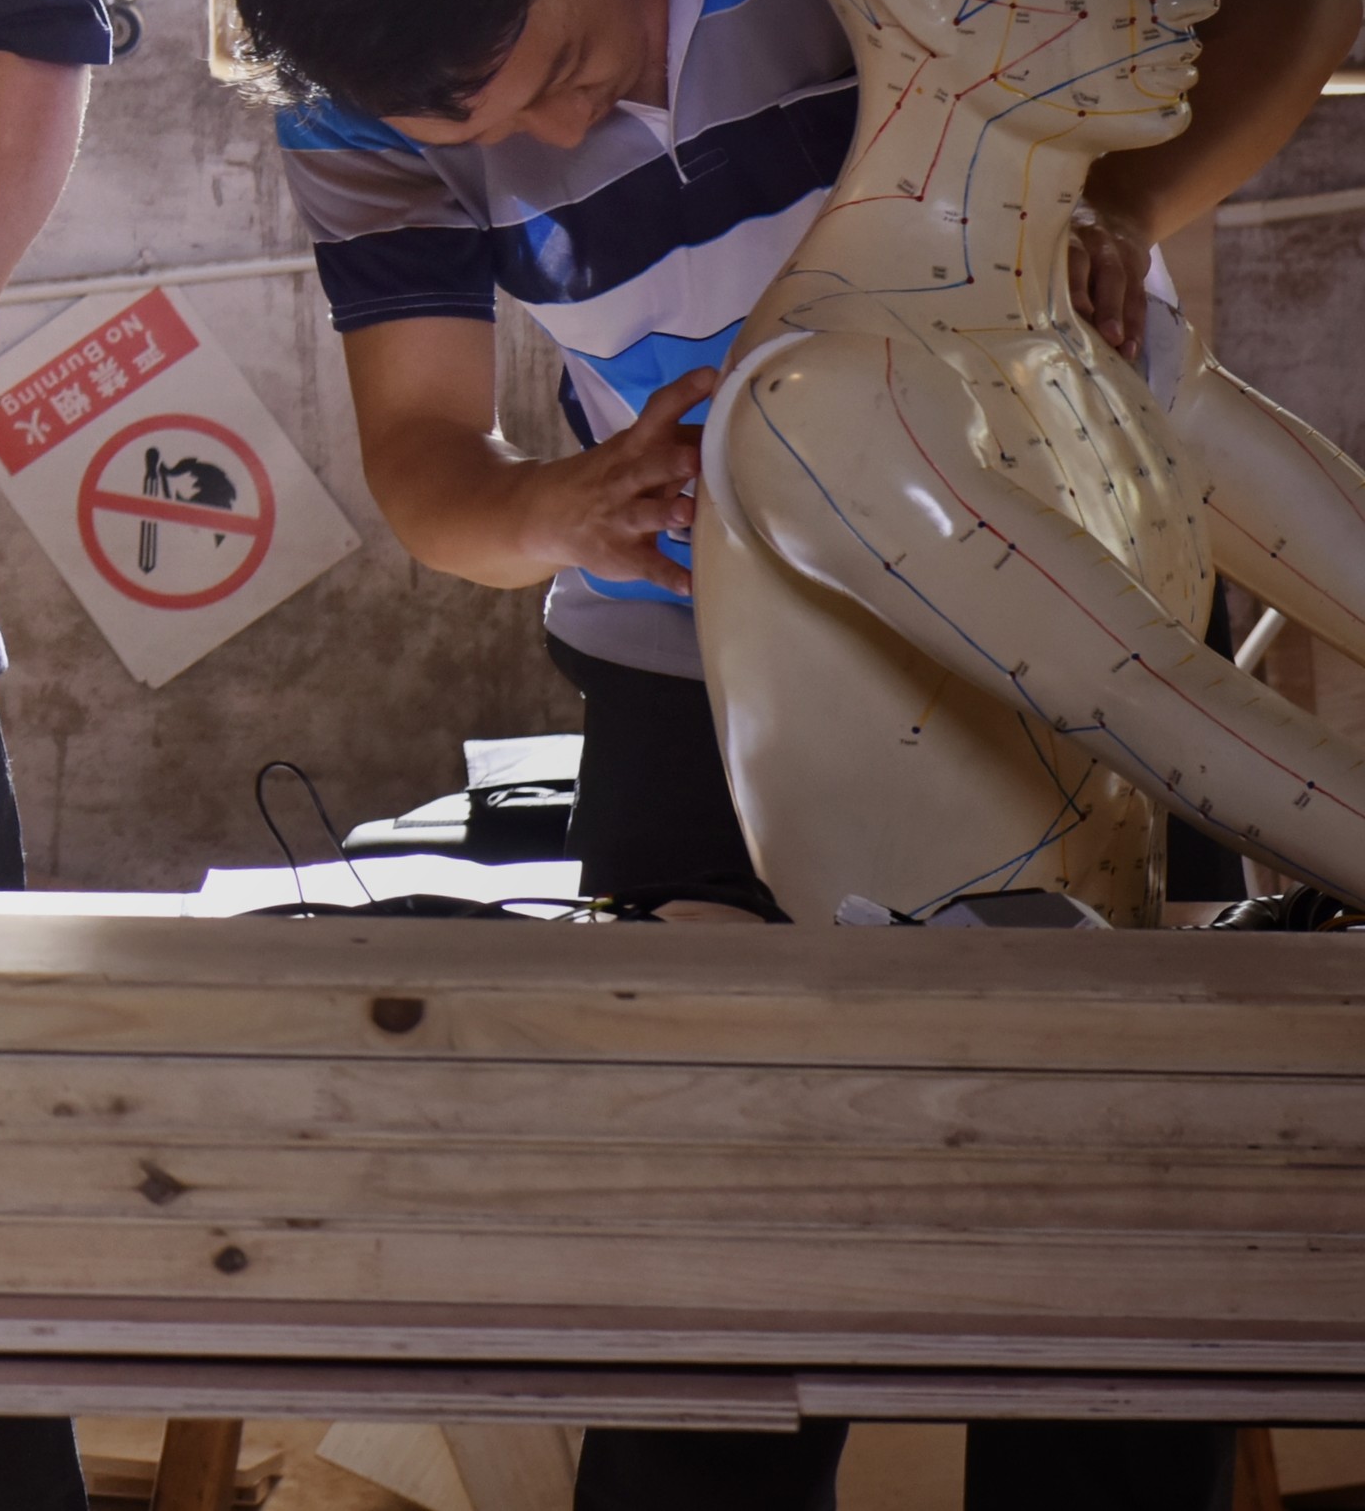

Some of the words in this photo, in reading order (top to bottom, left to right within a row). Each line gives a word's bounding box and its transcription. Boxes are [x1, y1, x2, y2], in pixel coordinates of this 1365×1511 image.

[106, 313, 144, 343] No
[0, 342, 106, 417] Burning
[13, 332, 166, 447] 严禁烟火
